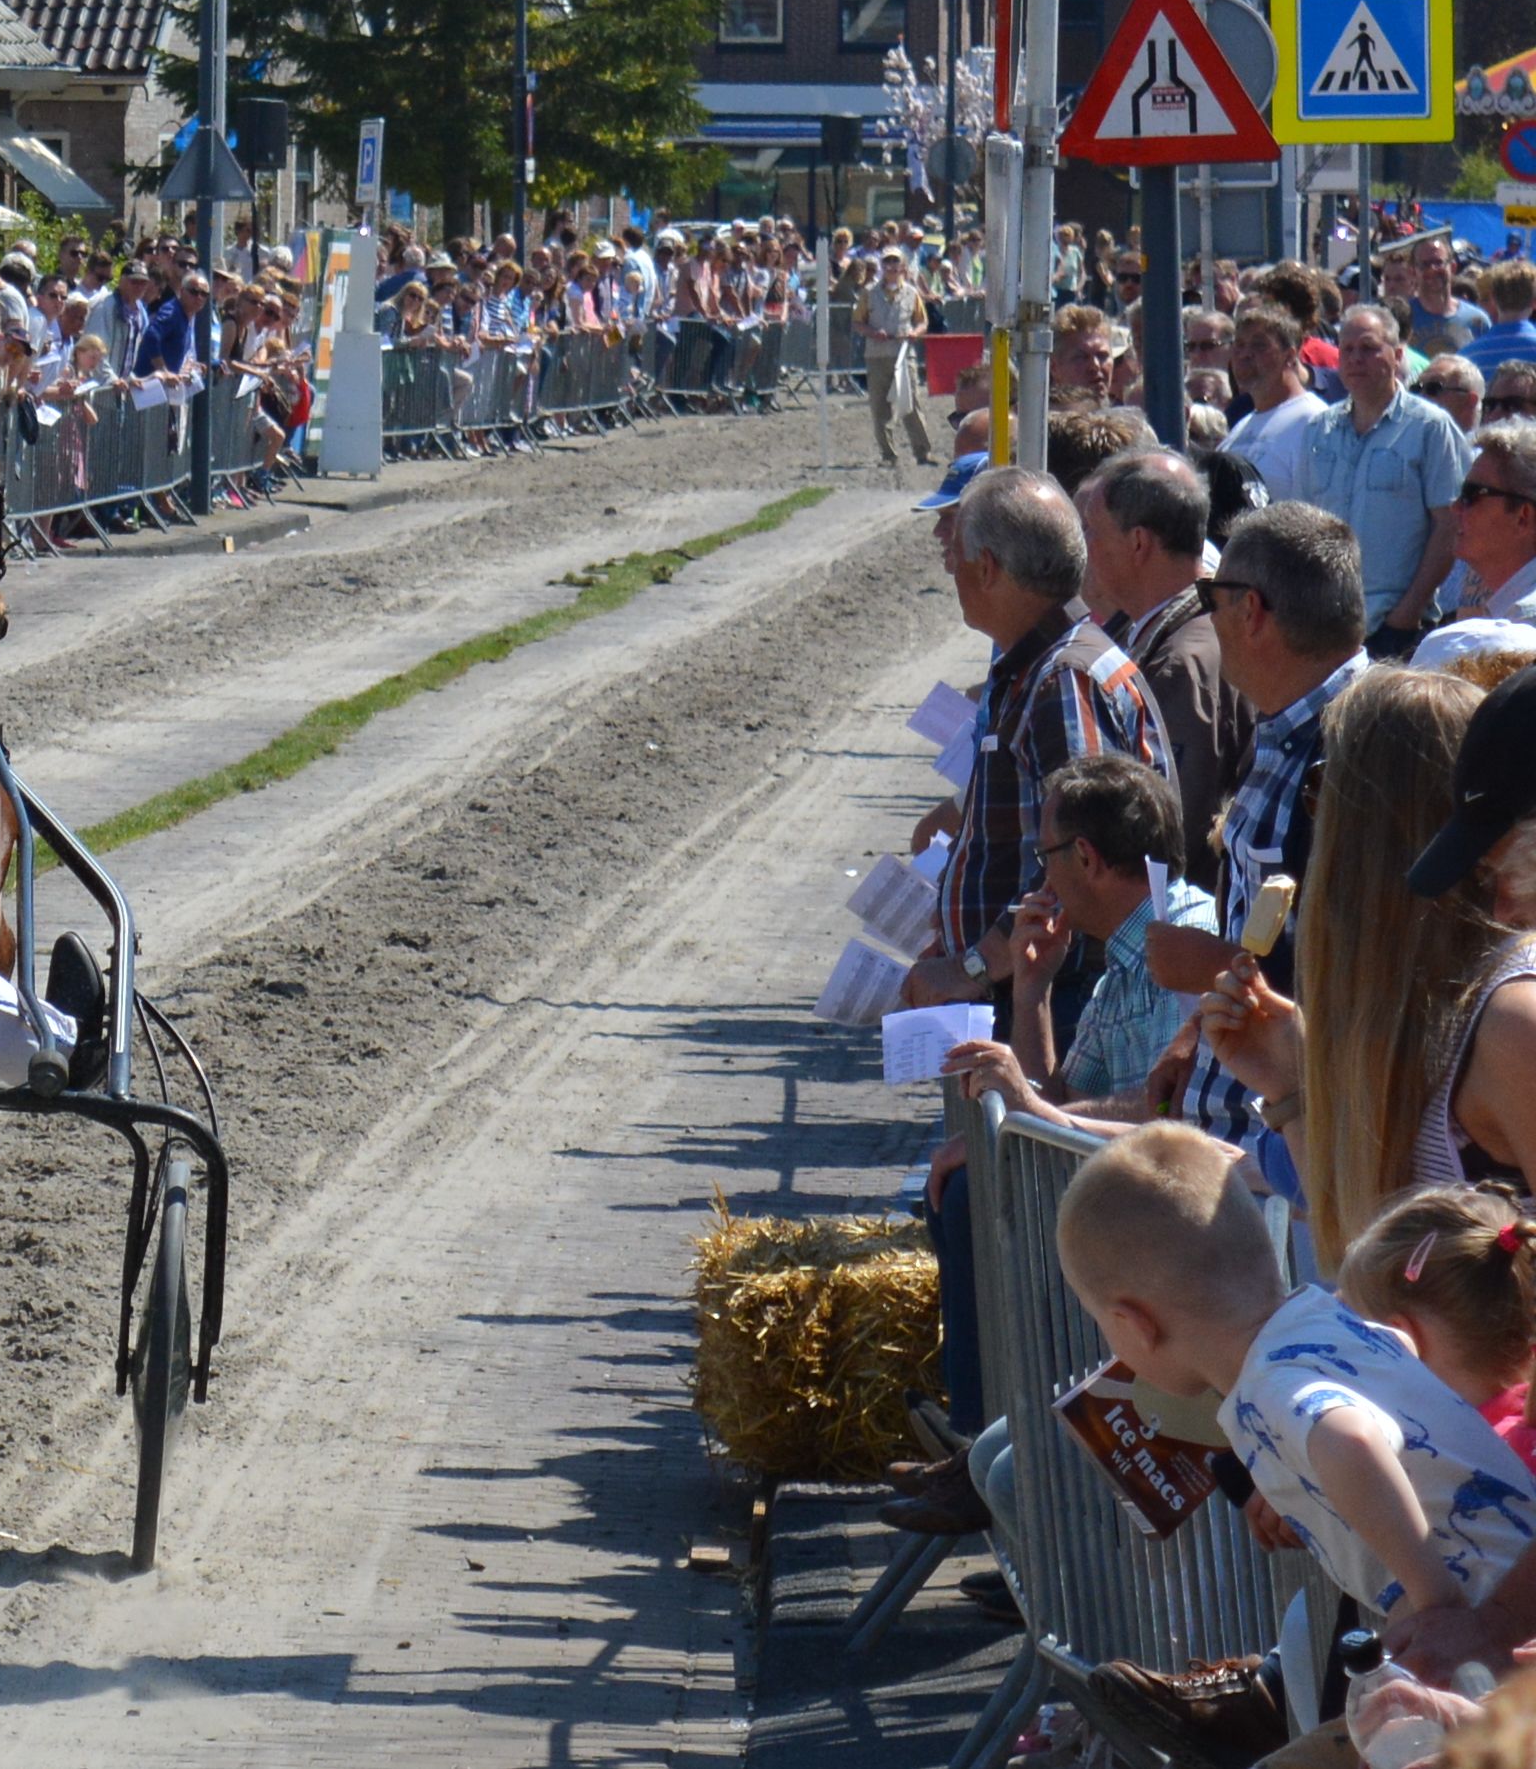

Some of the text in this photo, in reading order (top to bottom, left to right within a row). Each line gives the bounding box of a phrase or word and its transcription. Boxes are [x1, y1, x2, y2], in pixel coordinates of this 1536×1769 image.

[1103, 1404, 1186, 1511] Ice macs
[1139, 1413, 1162, 1441] 3
